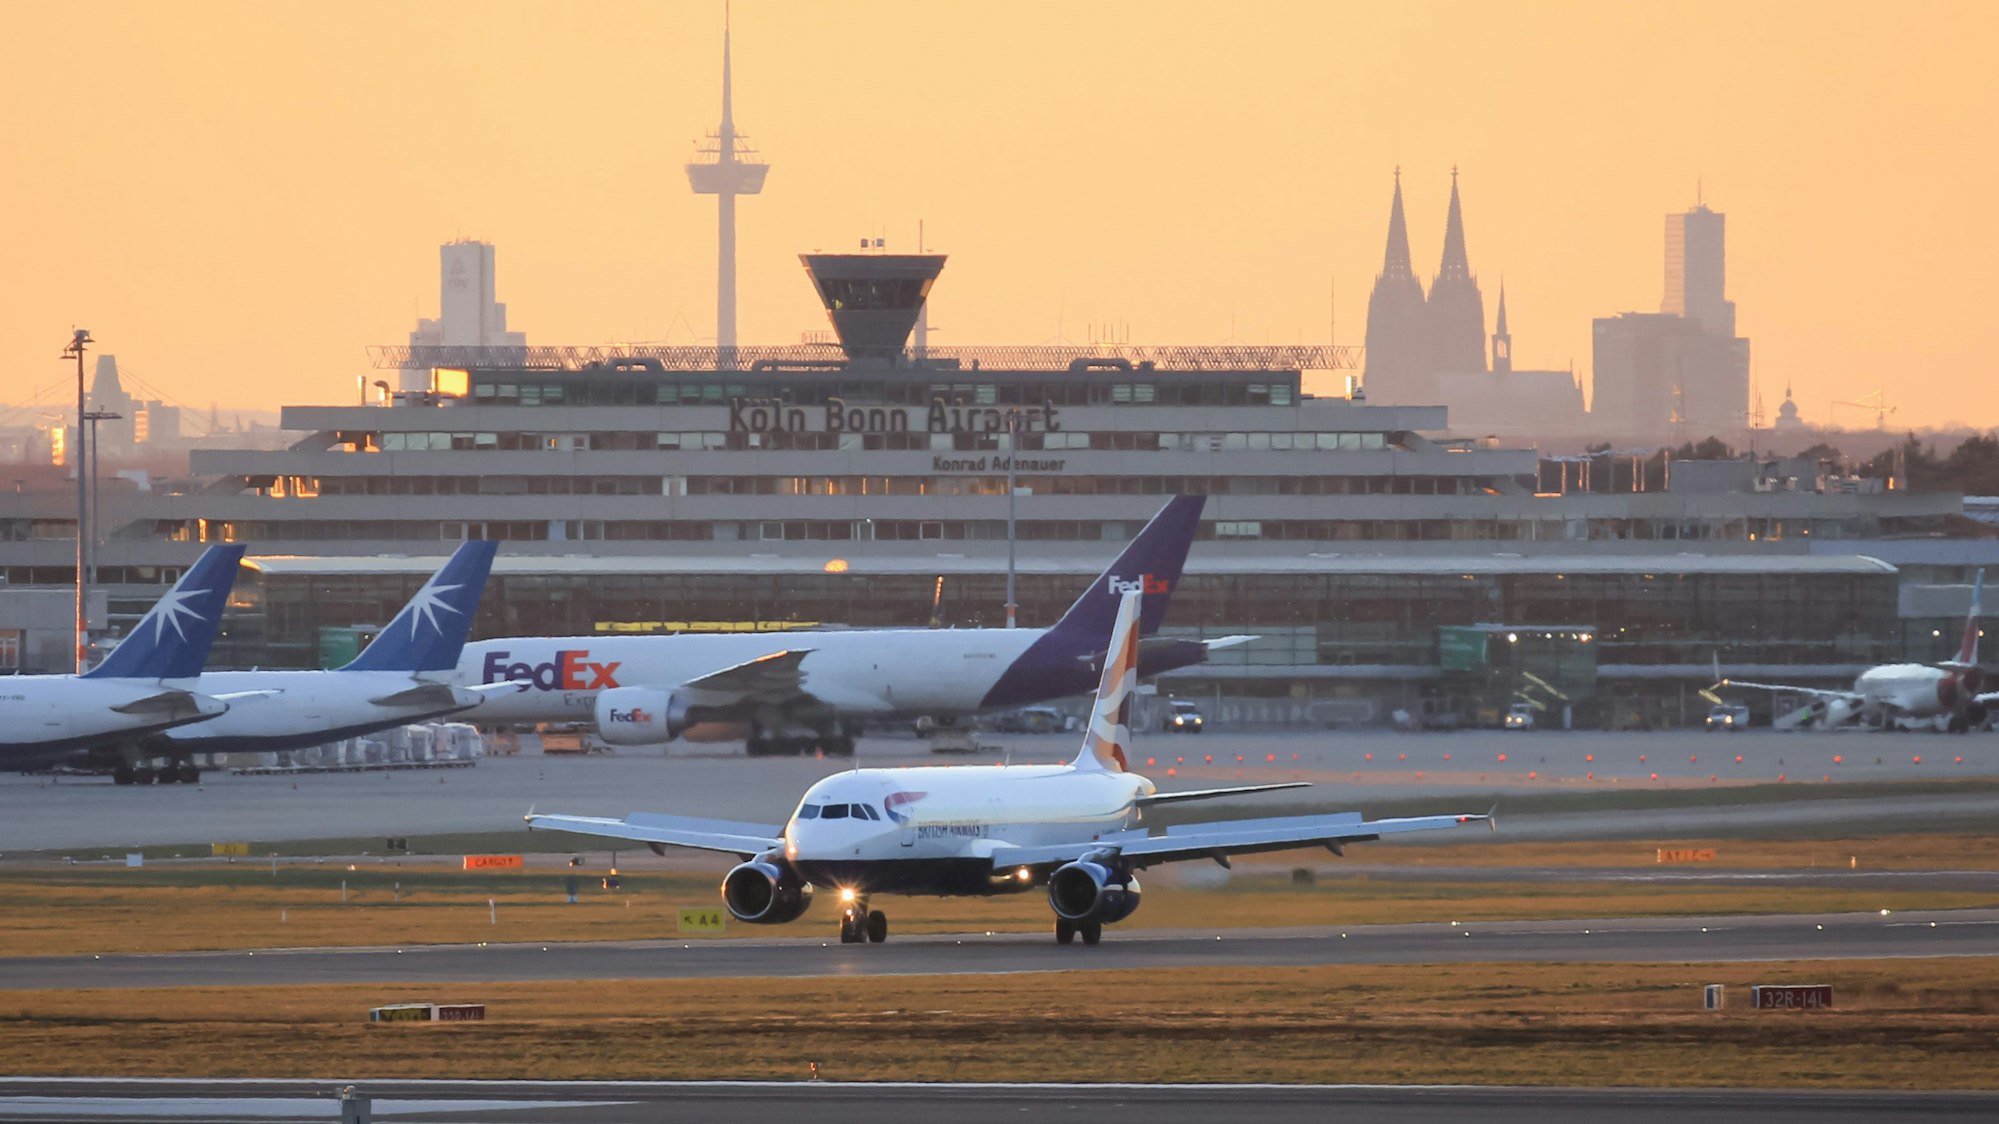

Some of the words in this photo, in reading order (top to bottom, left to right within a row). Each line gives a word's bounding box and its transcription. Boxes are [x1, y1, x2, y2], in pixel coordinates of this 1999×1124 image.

[730, 397, 805, 432] Köln
[826, 397, 908, 432] Bonn
[928, 397, 1060, 439] Airport
[932, 456, 986, 471] Konrad
[991, 456, 1066, 471] Adenauer
[1109, 574, 1168, 595] FedEx
[482, 650, 622, 692] FedEx
[610, 708, 653, 723] FedEx
[918, 821, 948, 839] BRITISH
[699, 914, 719, 926] A4
[1765, 991, 1826, 1008] 32R-14L
